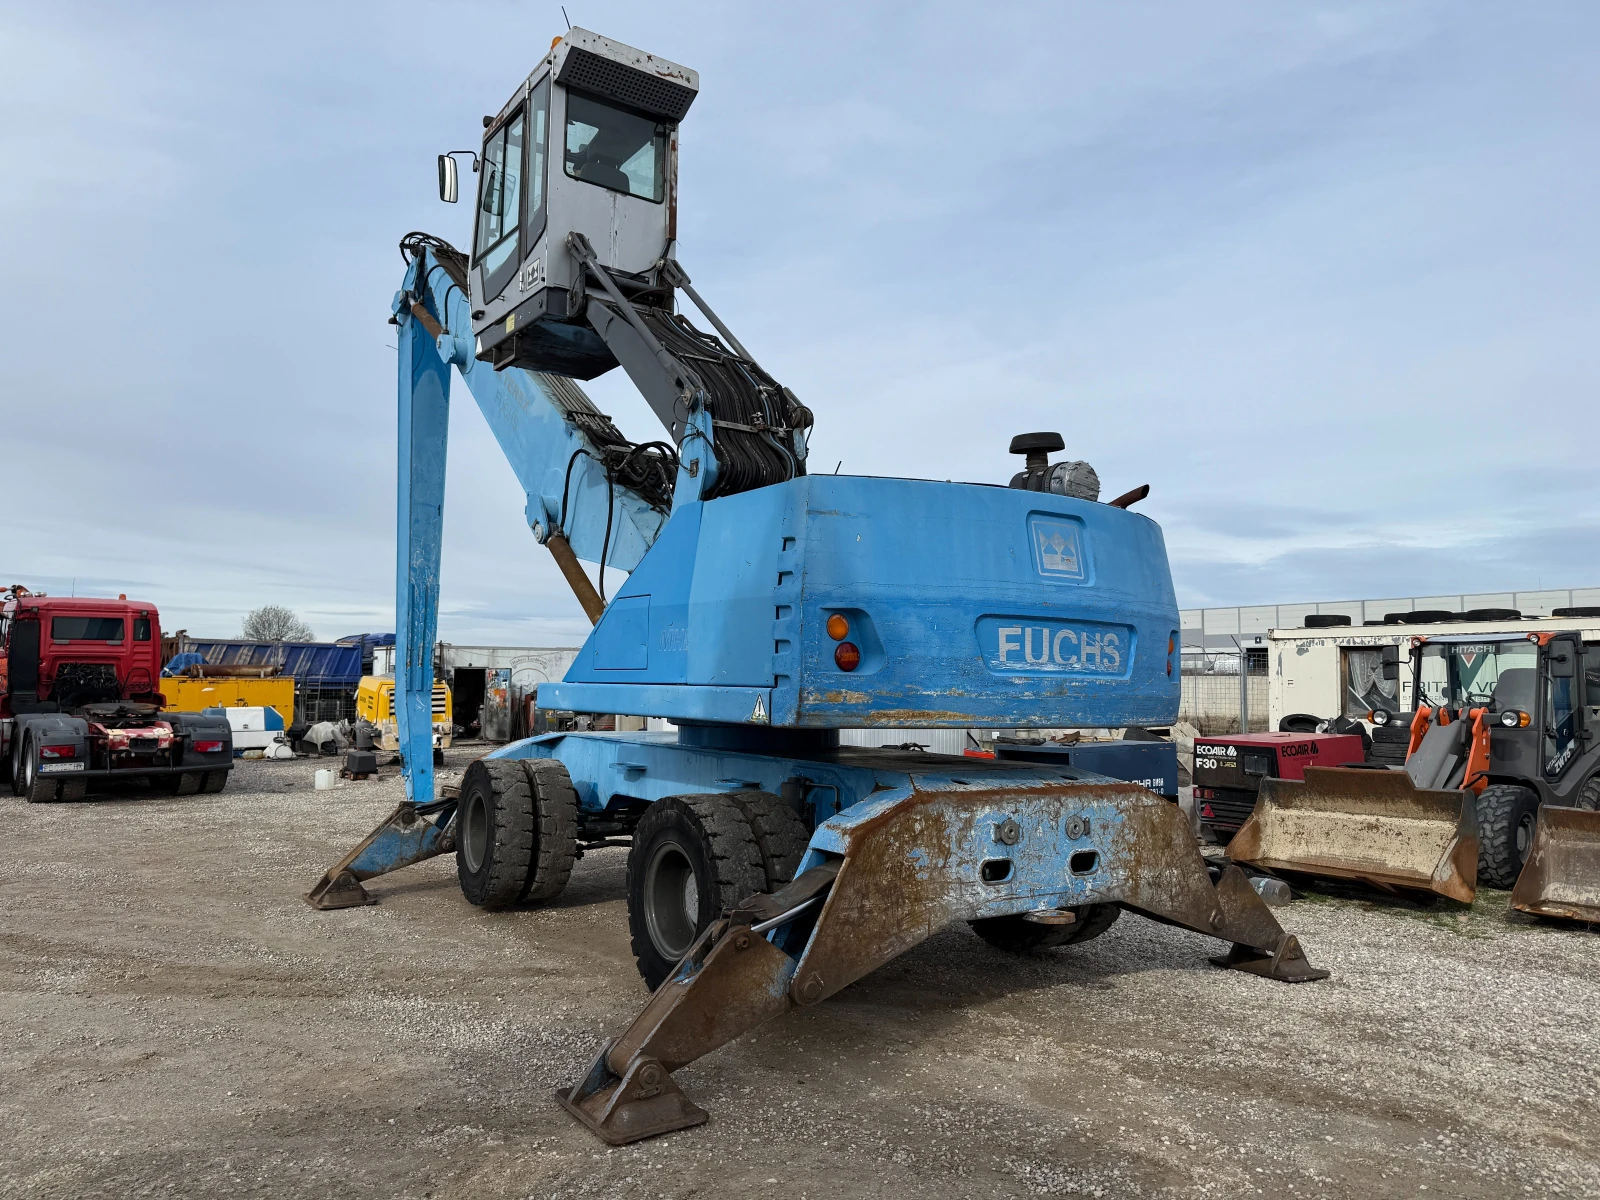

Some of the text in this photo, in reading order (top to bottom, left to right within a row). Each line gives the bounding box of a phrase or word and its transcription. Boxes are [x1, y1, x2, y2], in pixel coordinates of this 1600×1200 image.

[998, 627, 1120, 670] FUCHS
[1451, 645, 1496, 654] HITACHI
[1196, 745, 1227, 756] ECOAIR
[1281, 744, 1310, 758] ECOAIR
[1195, 757, 1218, 769] F30
[1554, 748, 1571, 774] ZW75
